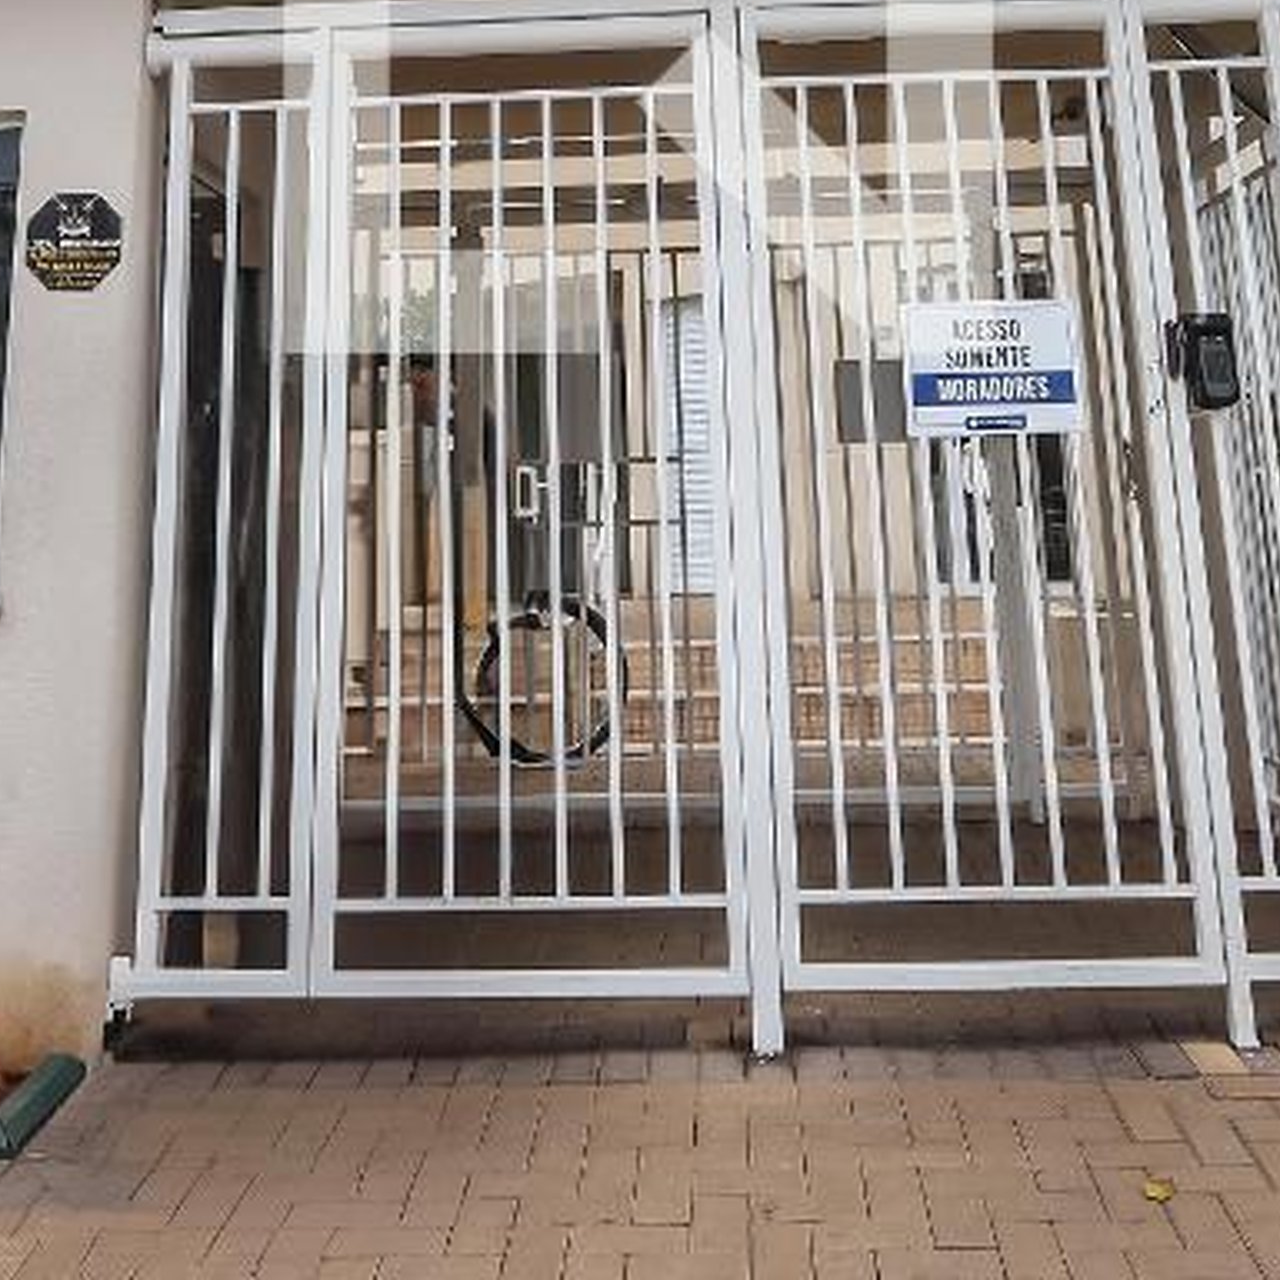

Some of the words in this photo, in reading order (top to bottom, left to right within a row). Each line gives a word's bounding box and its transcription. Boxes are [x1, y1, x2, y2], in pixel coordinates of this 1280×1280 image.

[951, 319, 1022, 341] ACESSO
[946, 345, 1032, 369] SOMENTE
[937, 375, 1050, 402] MORADORES
